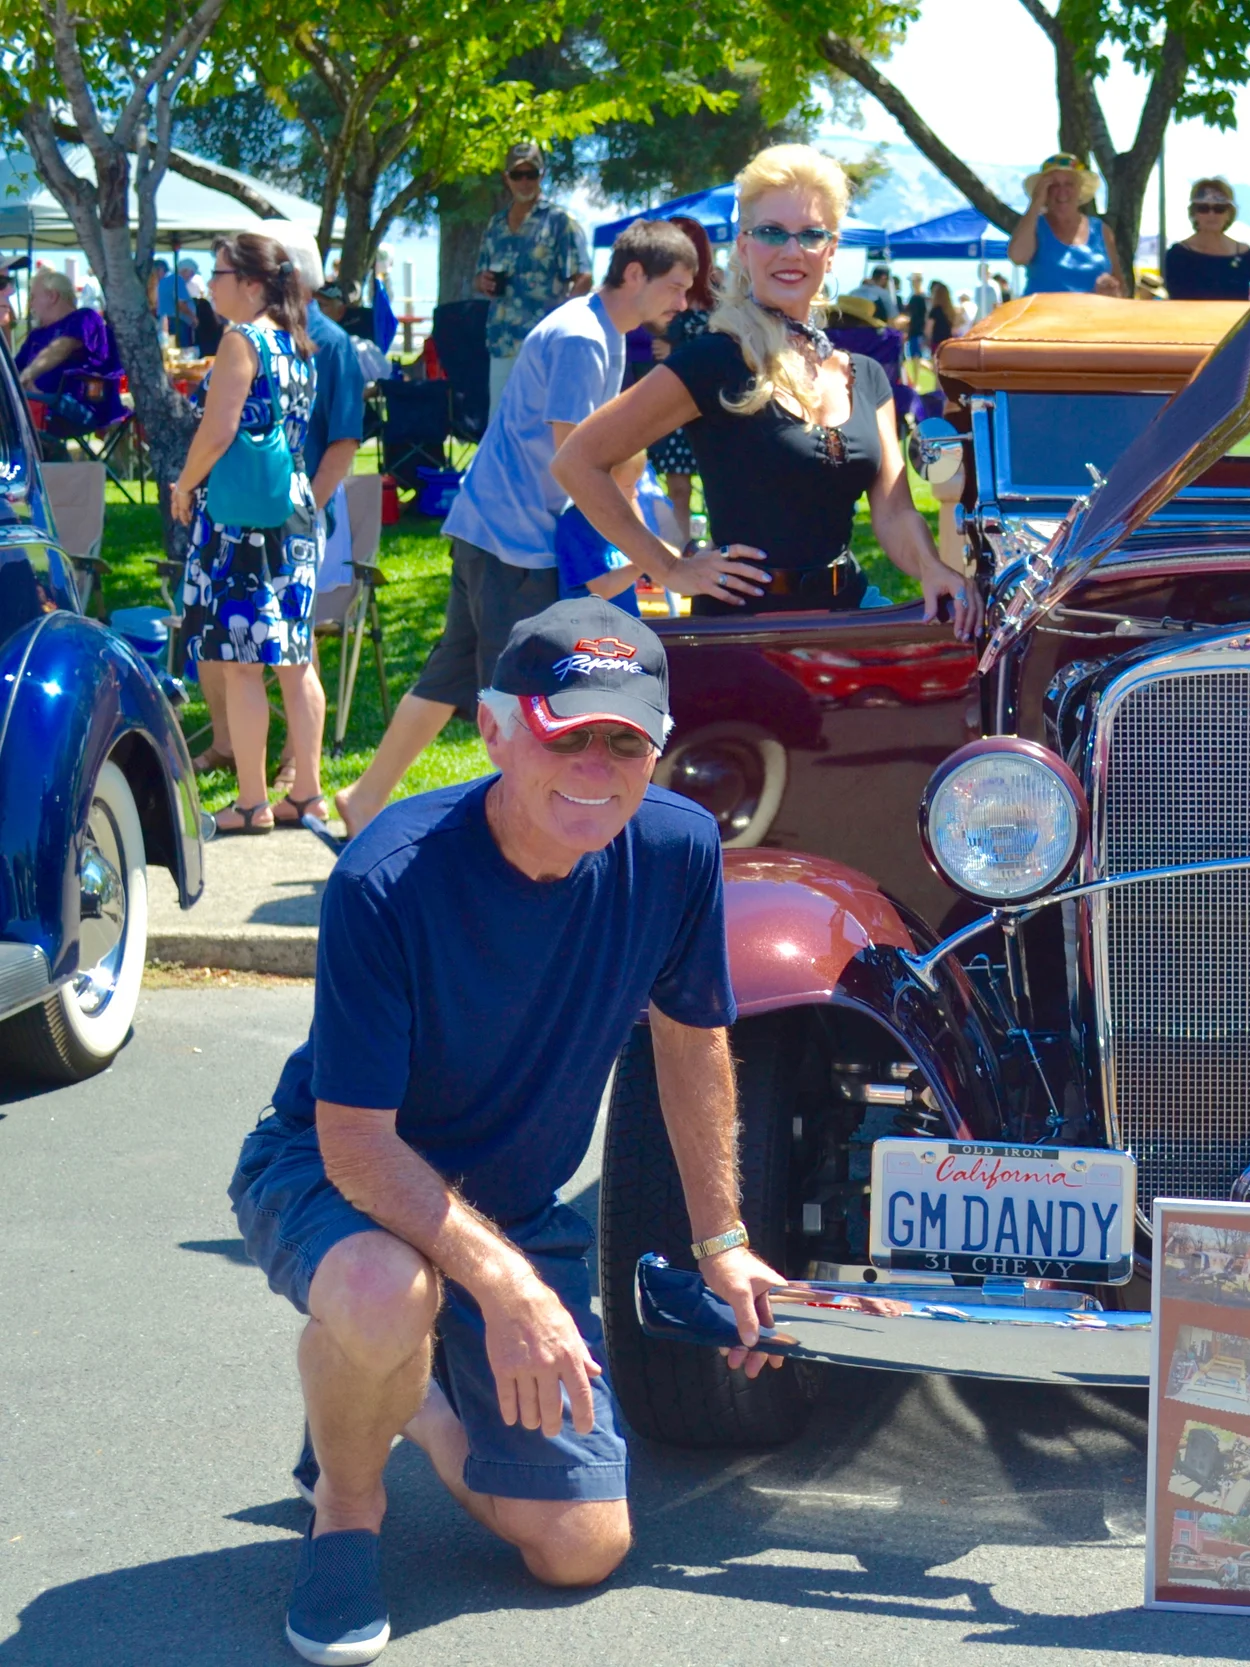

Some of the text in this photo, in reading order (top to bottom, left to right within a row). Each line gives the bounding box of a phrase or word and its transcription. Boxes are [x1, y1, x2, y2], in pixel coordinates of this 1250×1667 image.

[962, 1145, 1044, 1158] OLD IRON
[936, 1155, 1083, 1190] California
[888, 1190, 1118, 1260] GM DANDY
[924, 1254, 1075, 1278] 31 CHEVY
